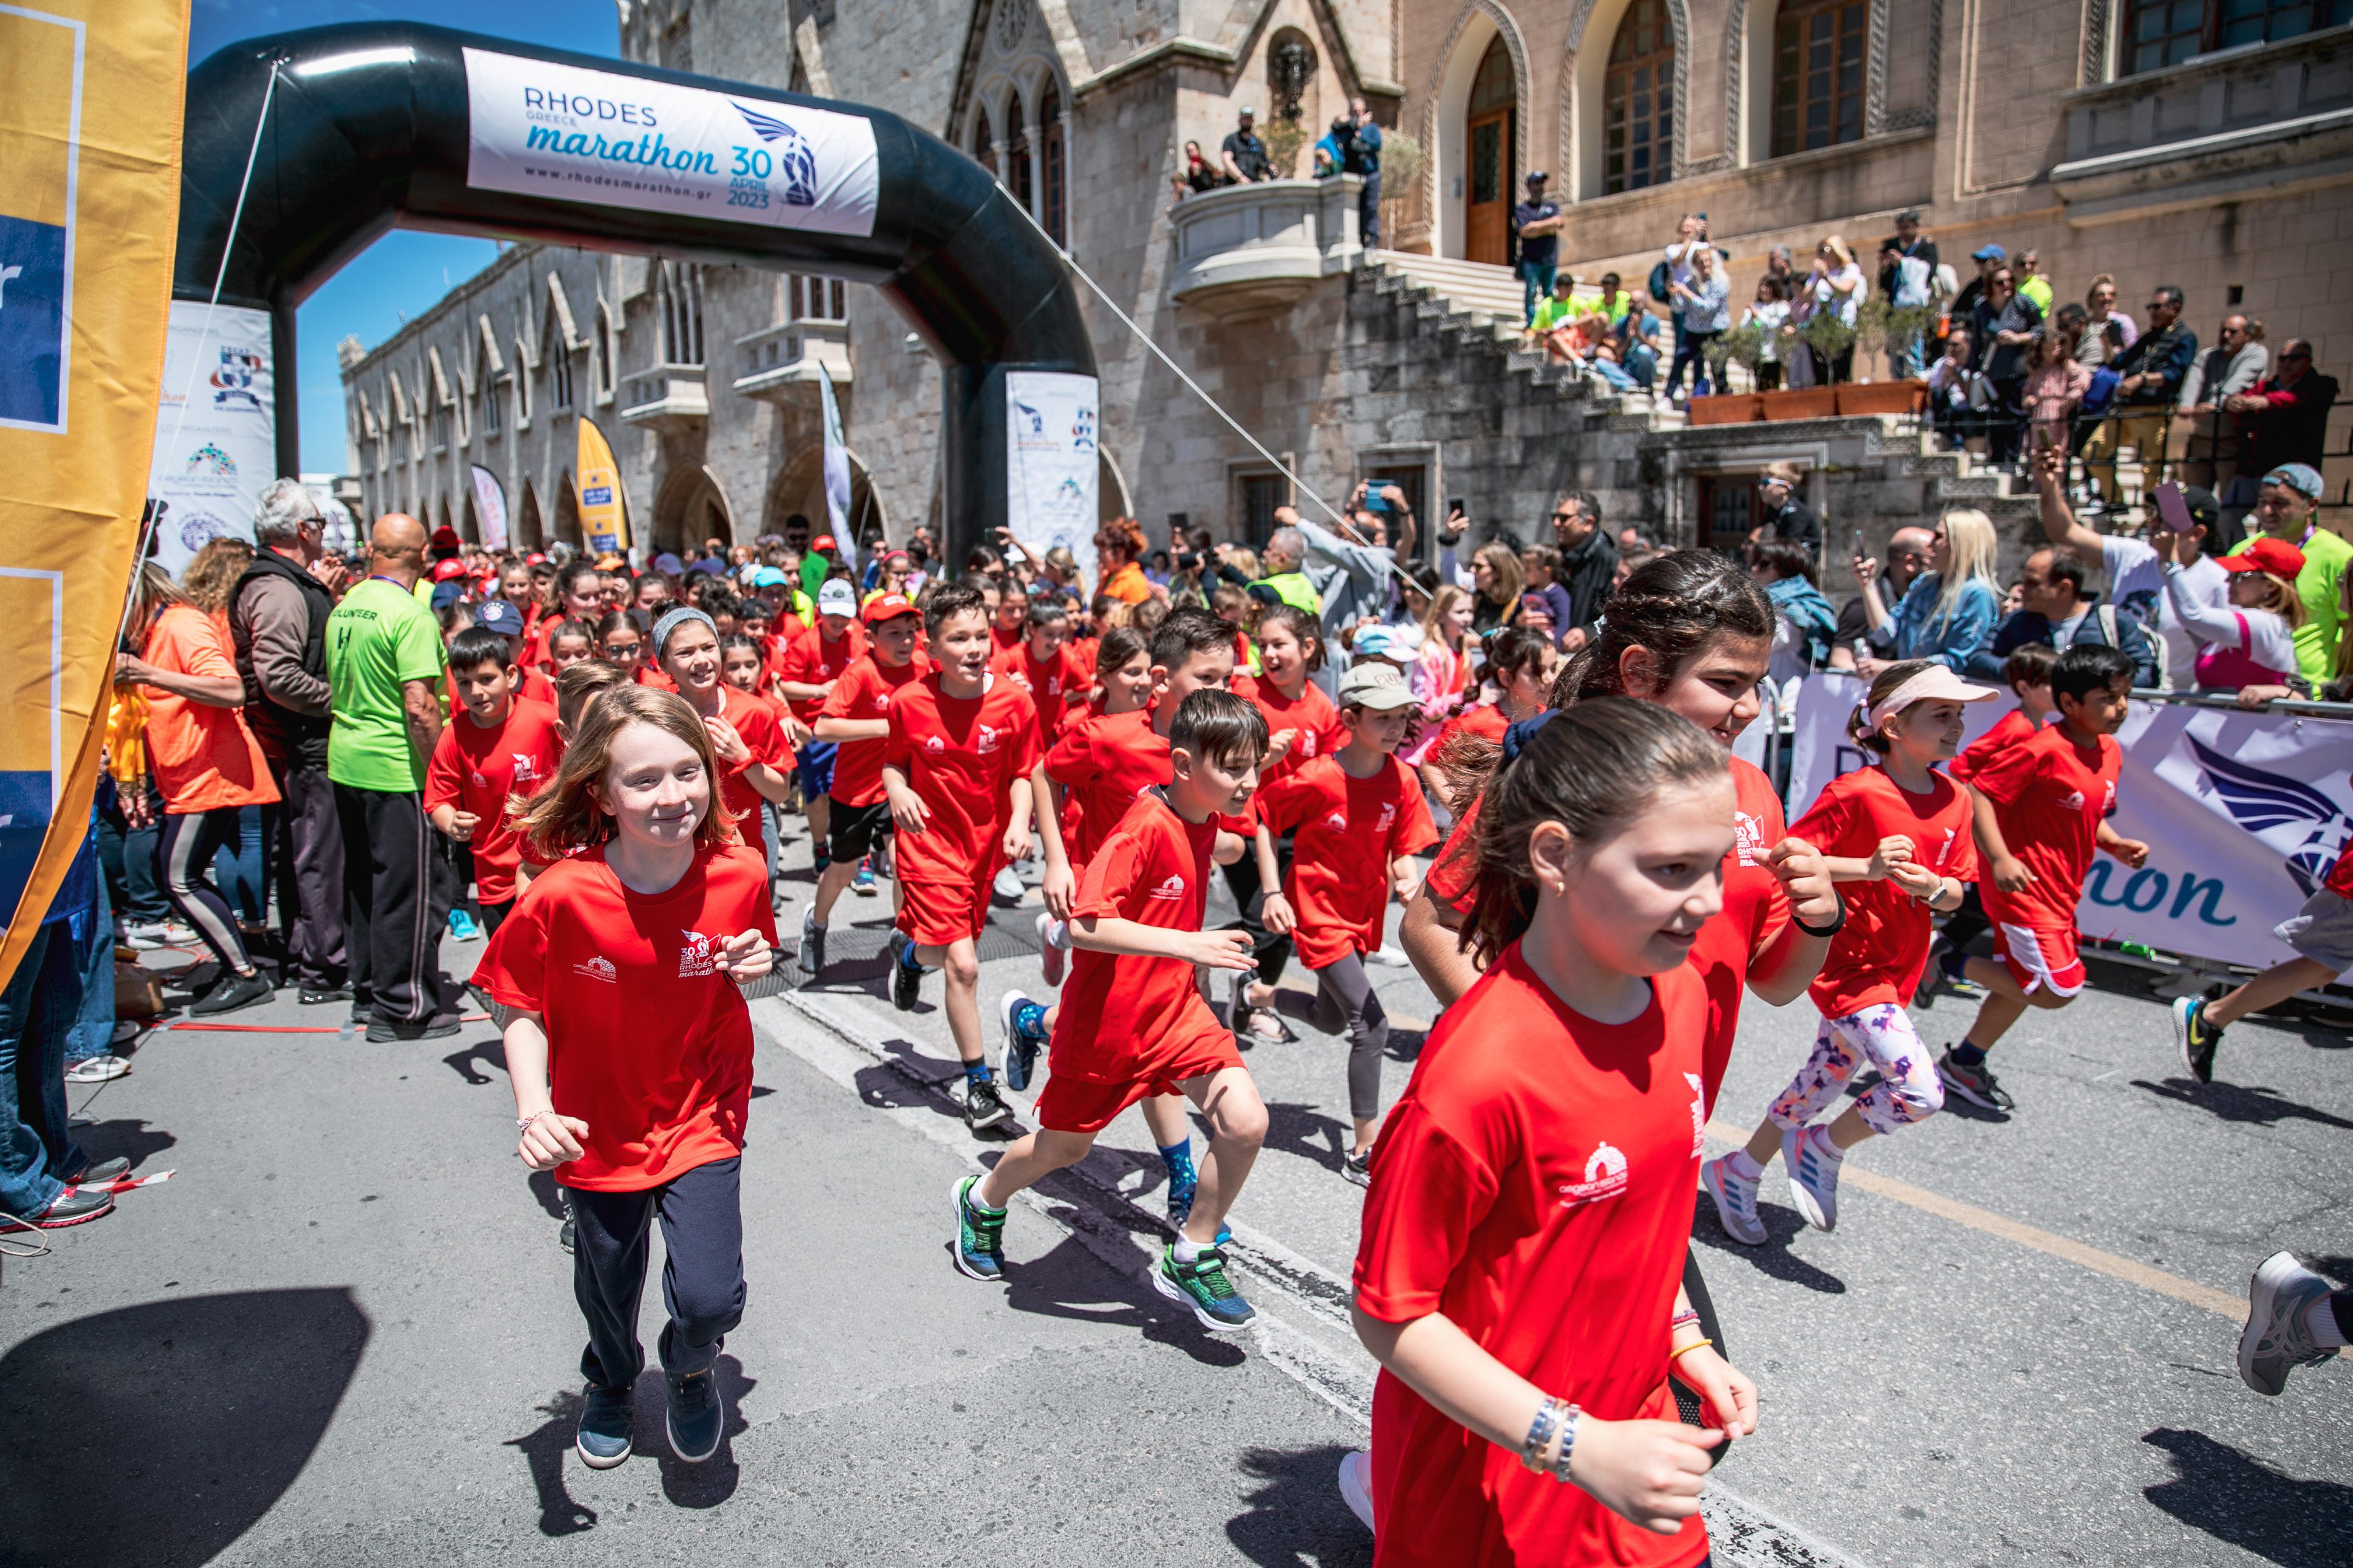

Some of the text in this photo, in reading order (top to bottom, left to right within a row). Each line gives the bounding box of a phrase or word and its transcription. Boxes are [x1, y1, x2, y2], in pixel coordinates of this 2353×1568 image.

[525, 87, 657, 126] RHODES
[526, 110, 578, 126] GREECE
[526, 126, 718, 174] marathon
[730, 146, 772, 179] 30
[524, 166, 712, 200] www.rhodesmarathon.gr
[729, 177, 767, 191] APRIL
[726, 190, 770, 210] 2023
[333, 609, 377, 621] OLUNTEER
[681, 947, 695, 957] 30
[679, 960, 712, 970] RHODES
